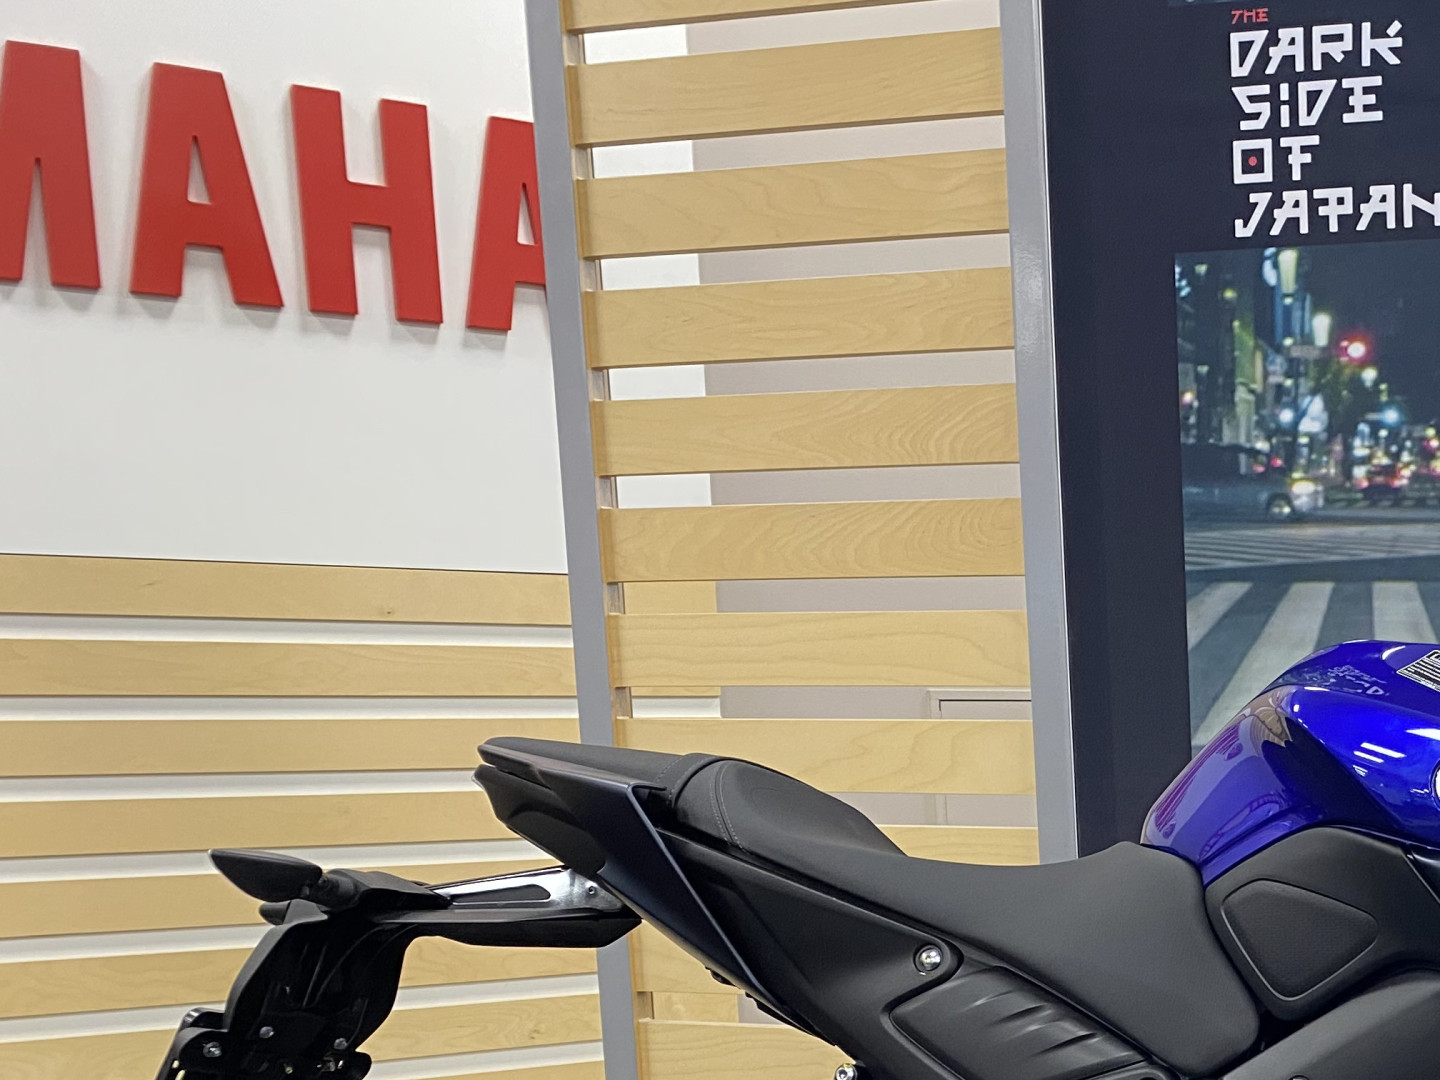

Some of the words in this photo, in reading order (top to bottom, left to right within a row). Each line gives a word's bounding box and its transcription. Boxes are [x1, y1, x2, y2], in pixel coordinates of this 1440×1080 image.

[1231, 8, 1269, 25] THE
[1229, 20, 1403, 78] DARK
[1232, 134, 1320, 185] OF
